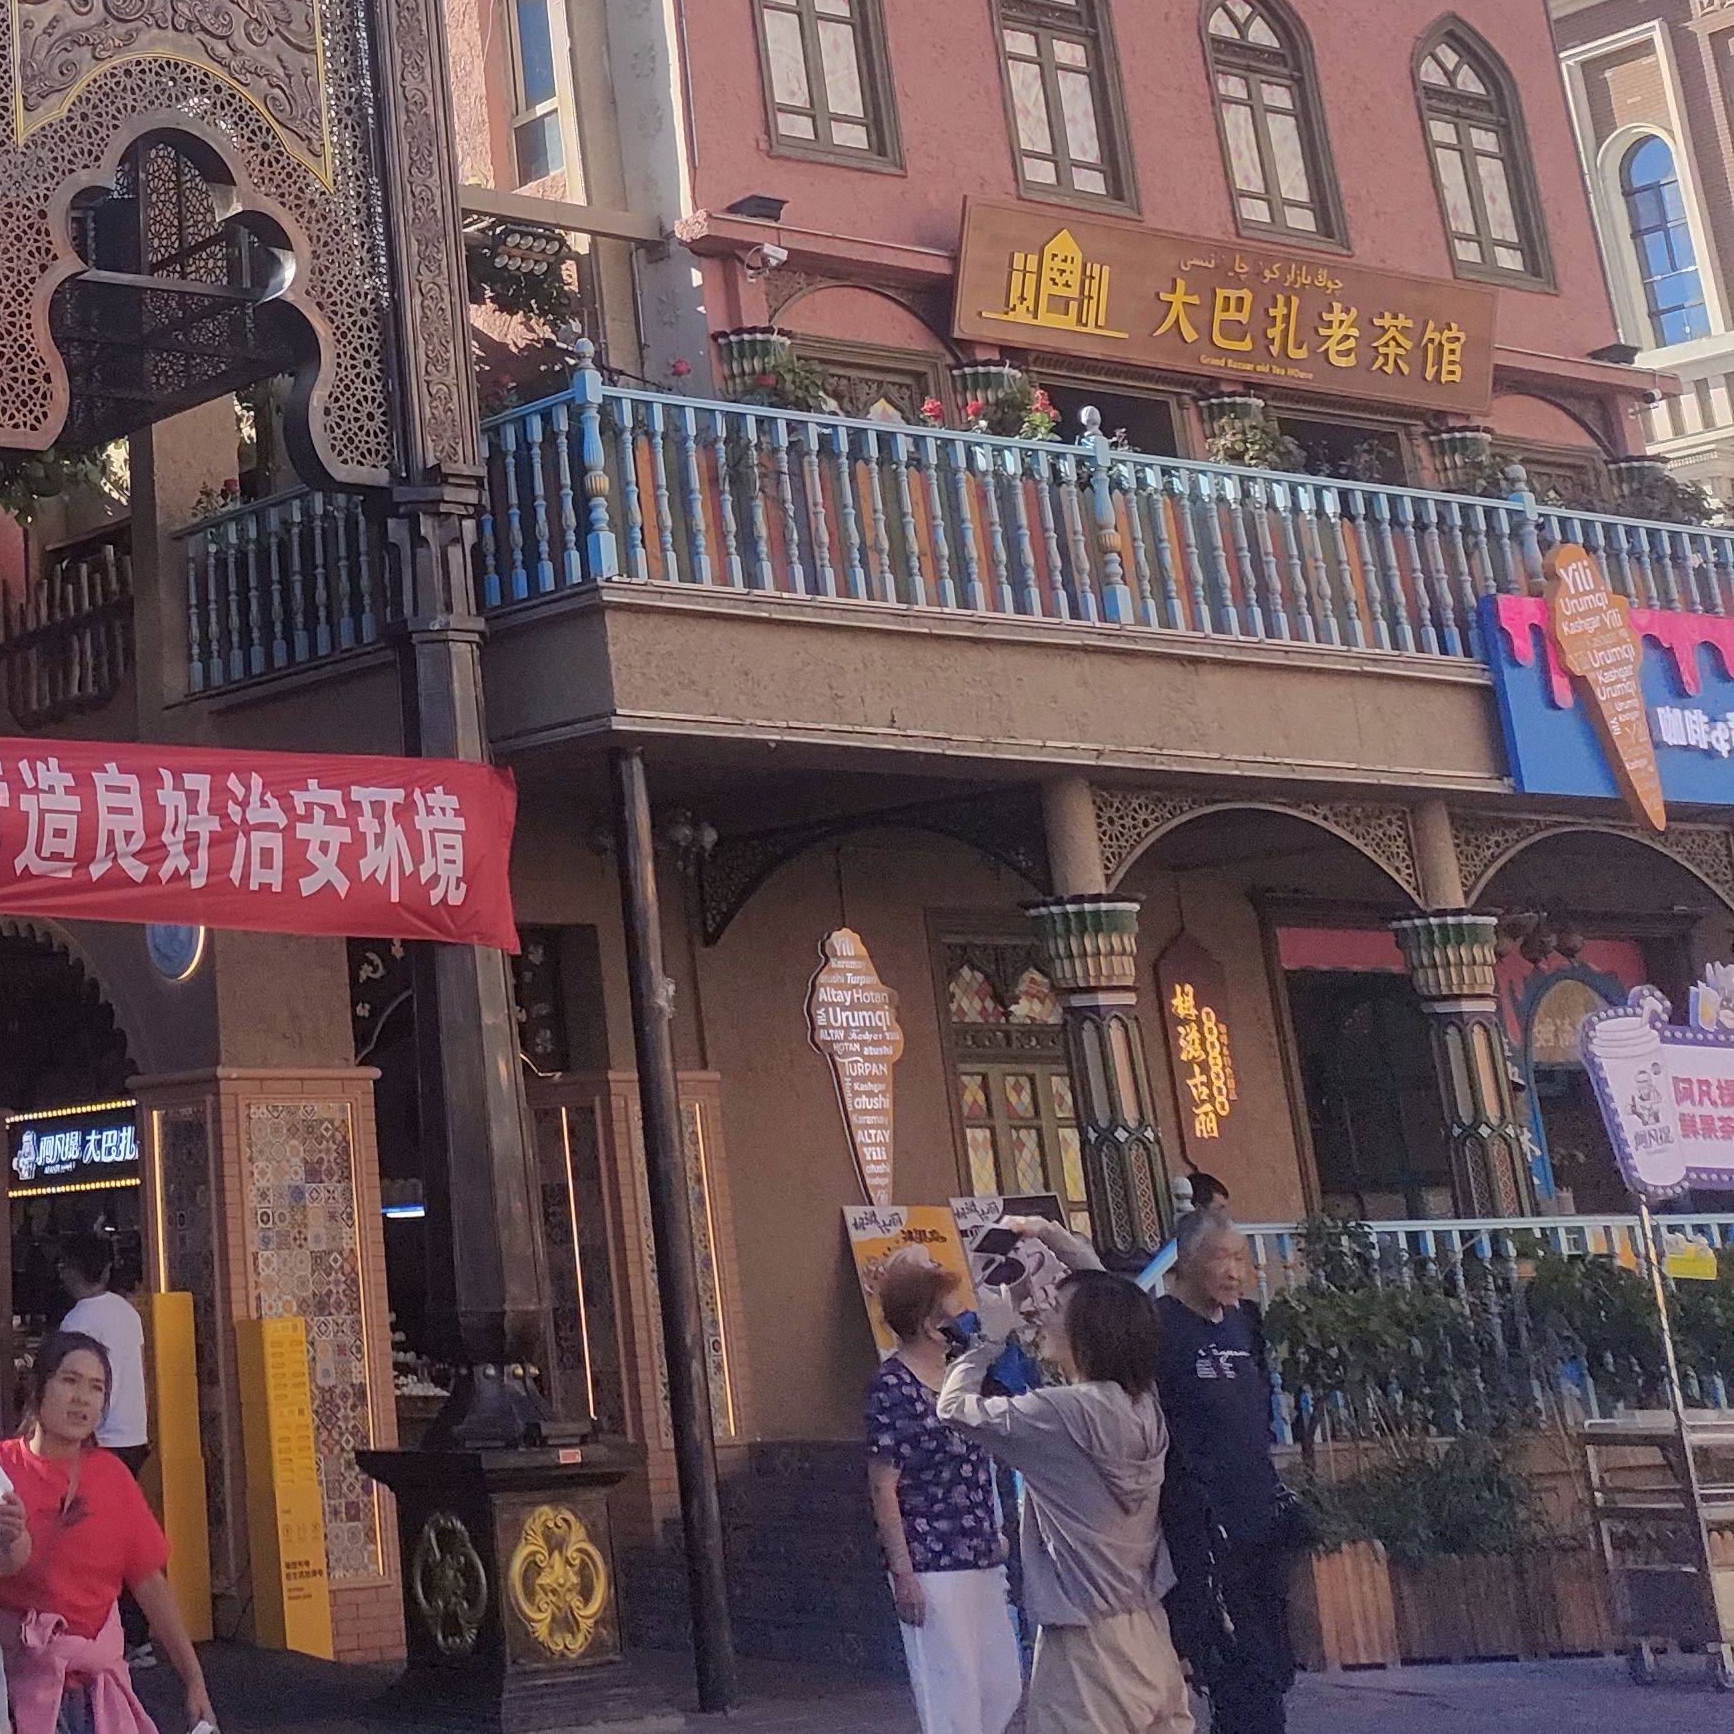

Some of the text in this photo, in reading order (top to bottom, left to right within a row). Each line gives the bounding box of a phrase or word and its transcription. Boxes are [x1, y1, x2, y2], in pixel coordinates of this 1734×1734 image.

[1153, 277, 1466, 385] 大巴扎老茶馆
[1199, 355, 1226, 367] Grand
[1559, 560, 1594, 594] Yili
[1560, 586, 1608, 615] Urumqi
[1562, 608, 1623, 635] Kashgar Yili
[1588, 638, 1635, 667] Urumqi
[1596, 665, 1634, 684] Kashgar
[1597, 679, 1637, 700] Urumqi
[833, 937, 855, 956] Yili
[818, 986, 889, 1006] Altay Hotan
[828, 1004, 891, 1031] Urumqi
[819, 1029, 844, 1040] ALTAY
[833, 1043, 893, 1055] HOTAN atushi
[854, 1093, 890, 1109] atushi
[82, 1125, 138, 1164] 大巴扎
[857, 1129, 890, 1143] ALTAY
[863, 1146, 887, 1160] Yili
